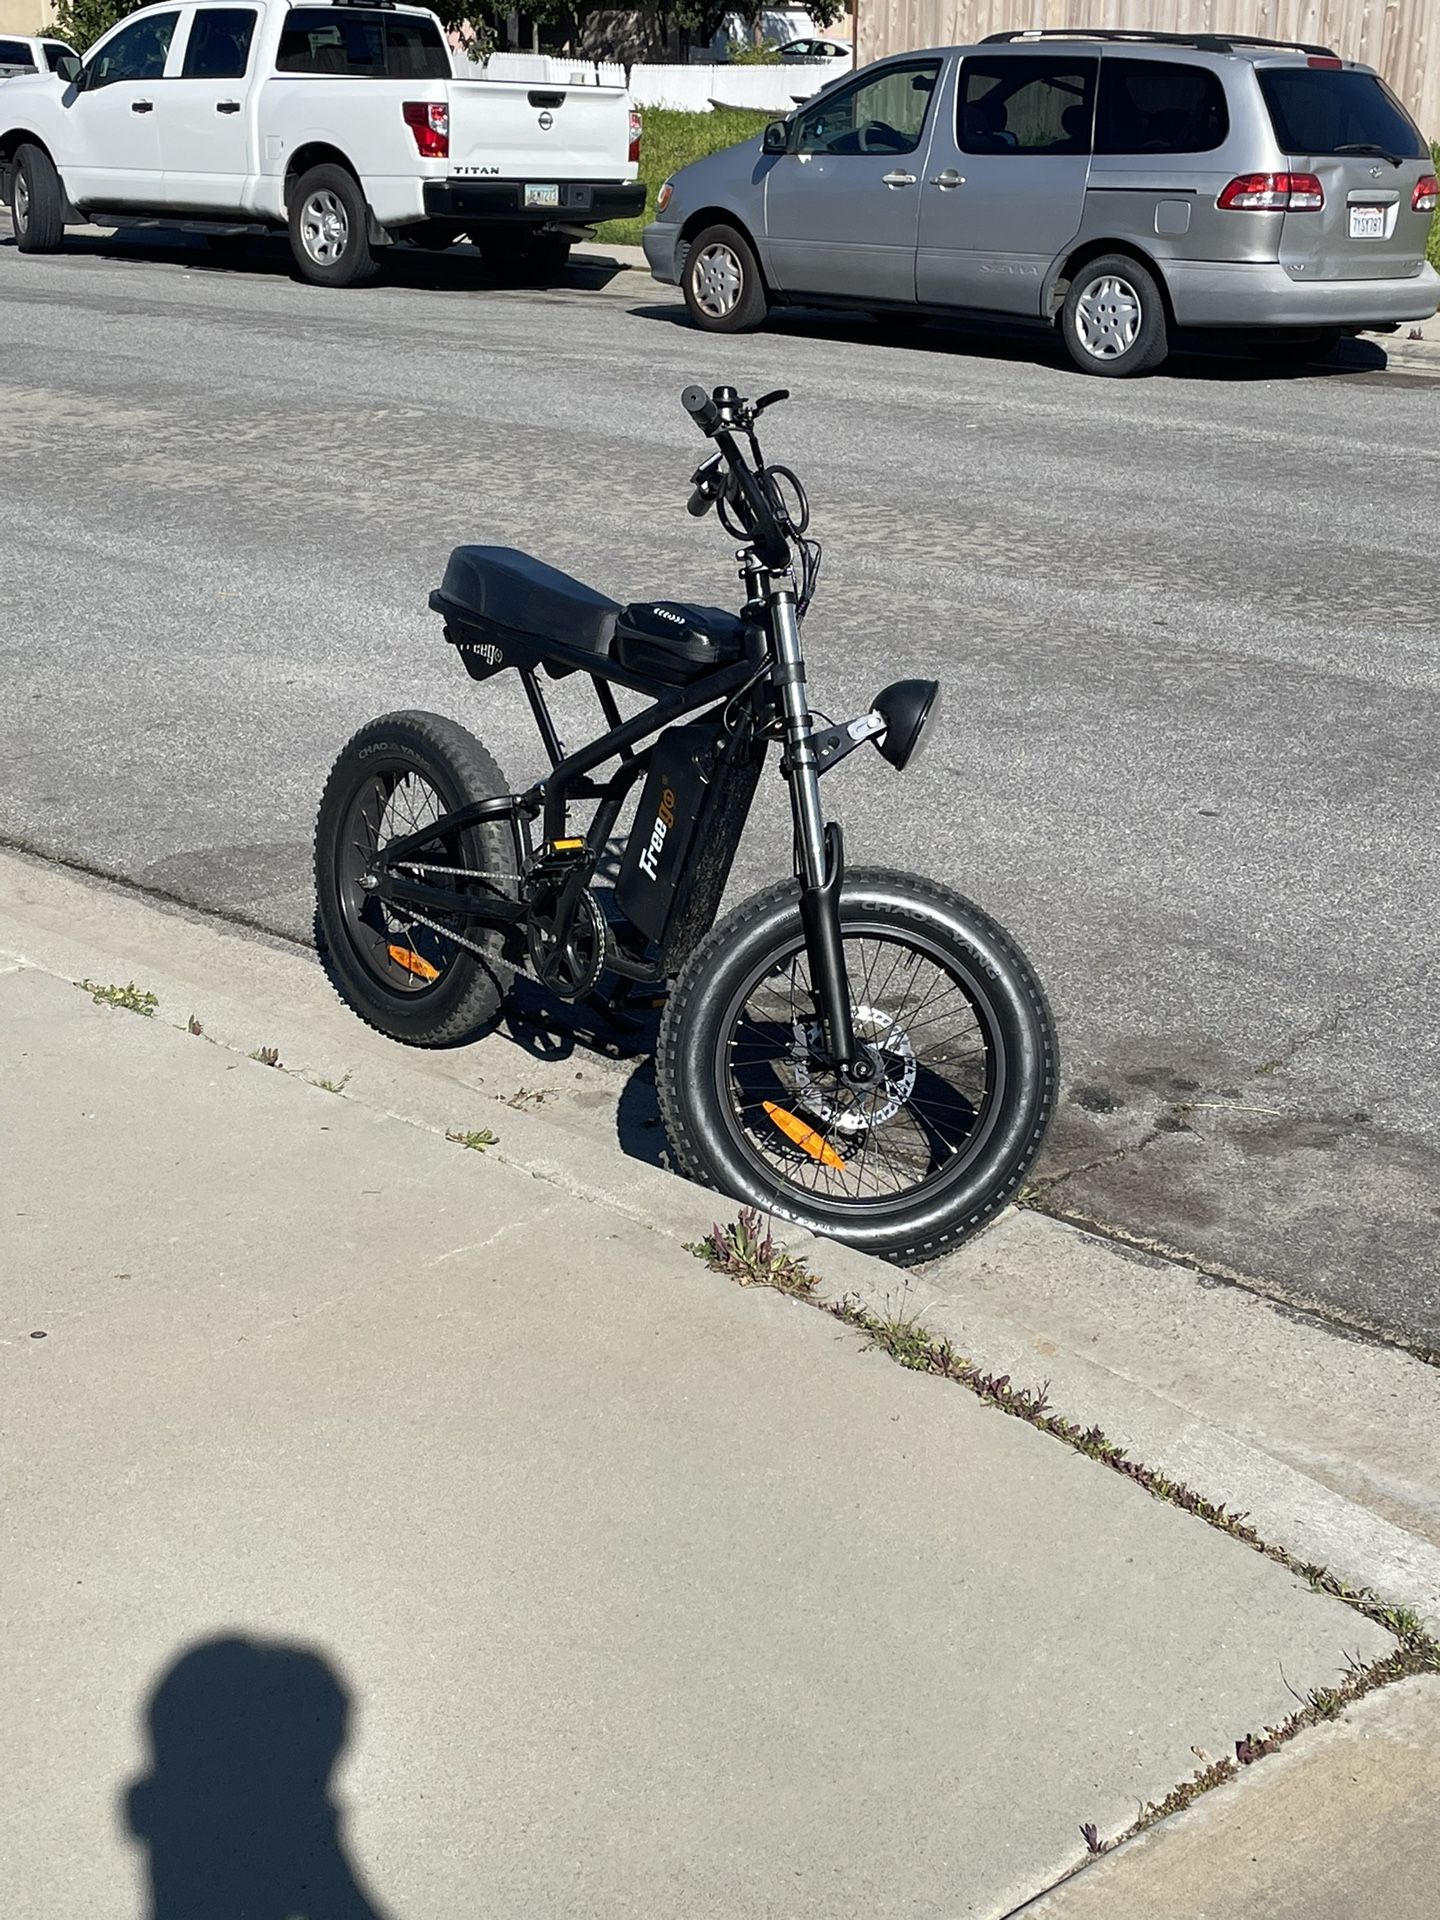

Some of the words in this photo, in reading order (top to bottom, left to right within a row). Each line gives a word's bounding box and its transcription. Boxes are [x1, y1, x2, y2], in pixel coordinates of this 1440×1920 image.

[453, 166, 500, 175] TITAN
[639, 788, 675, 882] Freego
[861, 901, 928, 922] CHAO
[952, 930, 1001, 980] YANG
